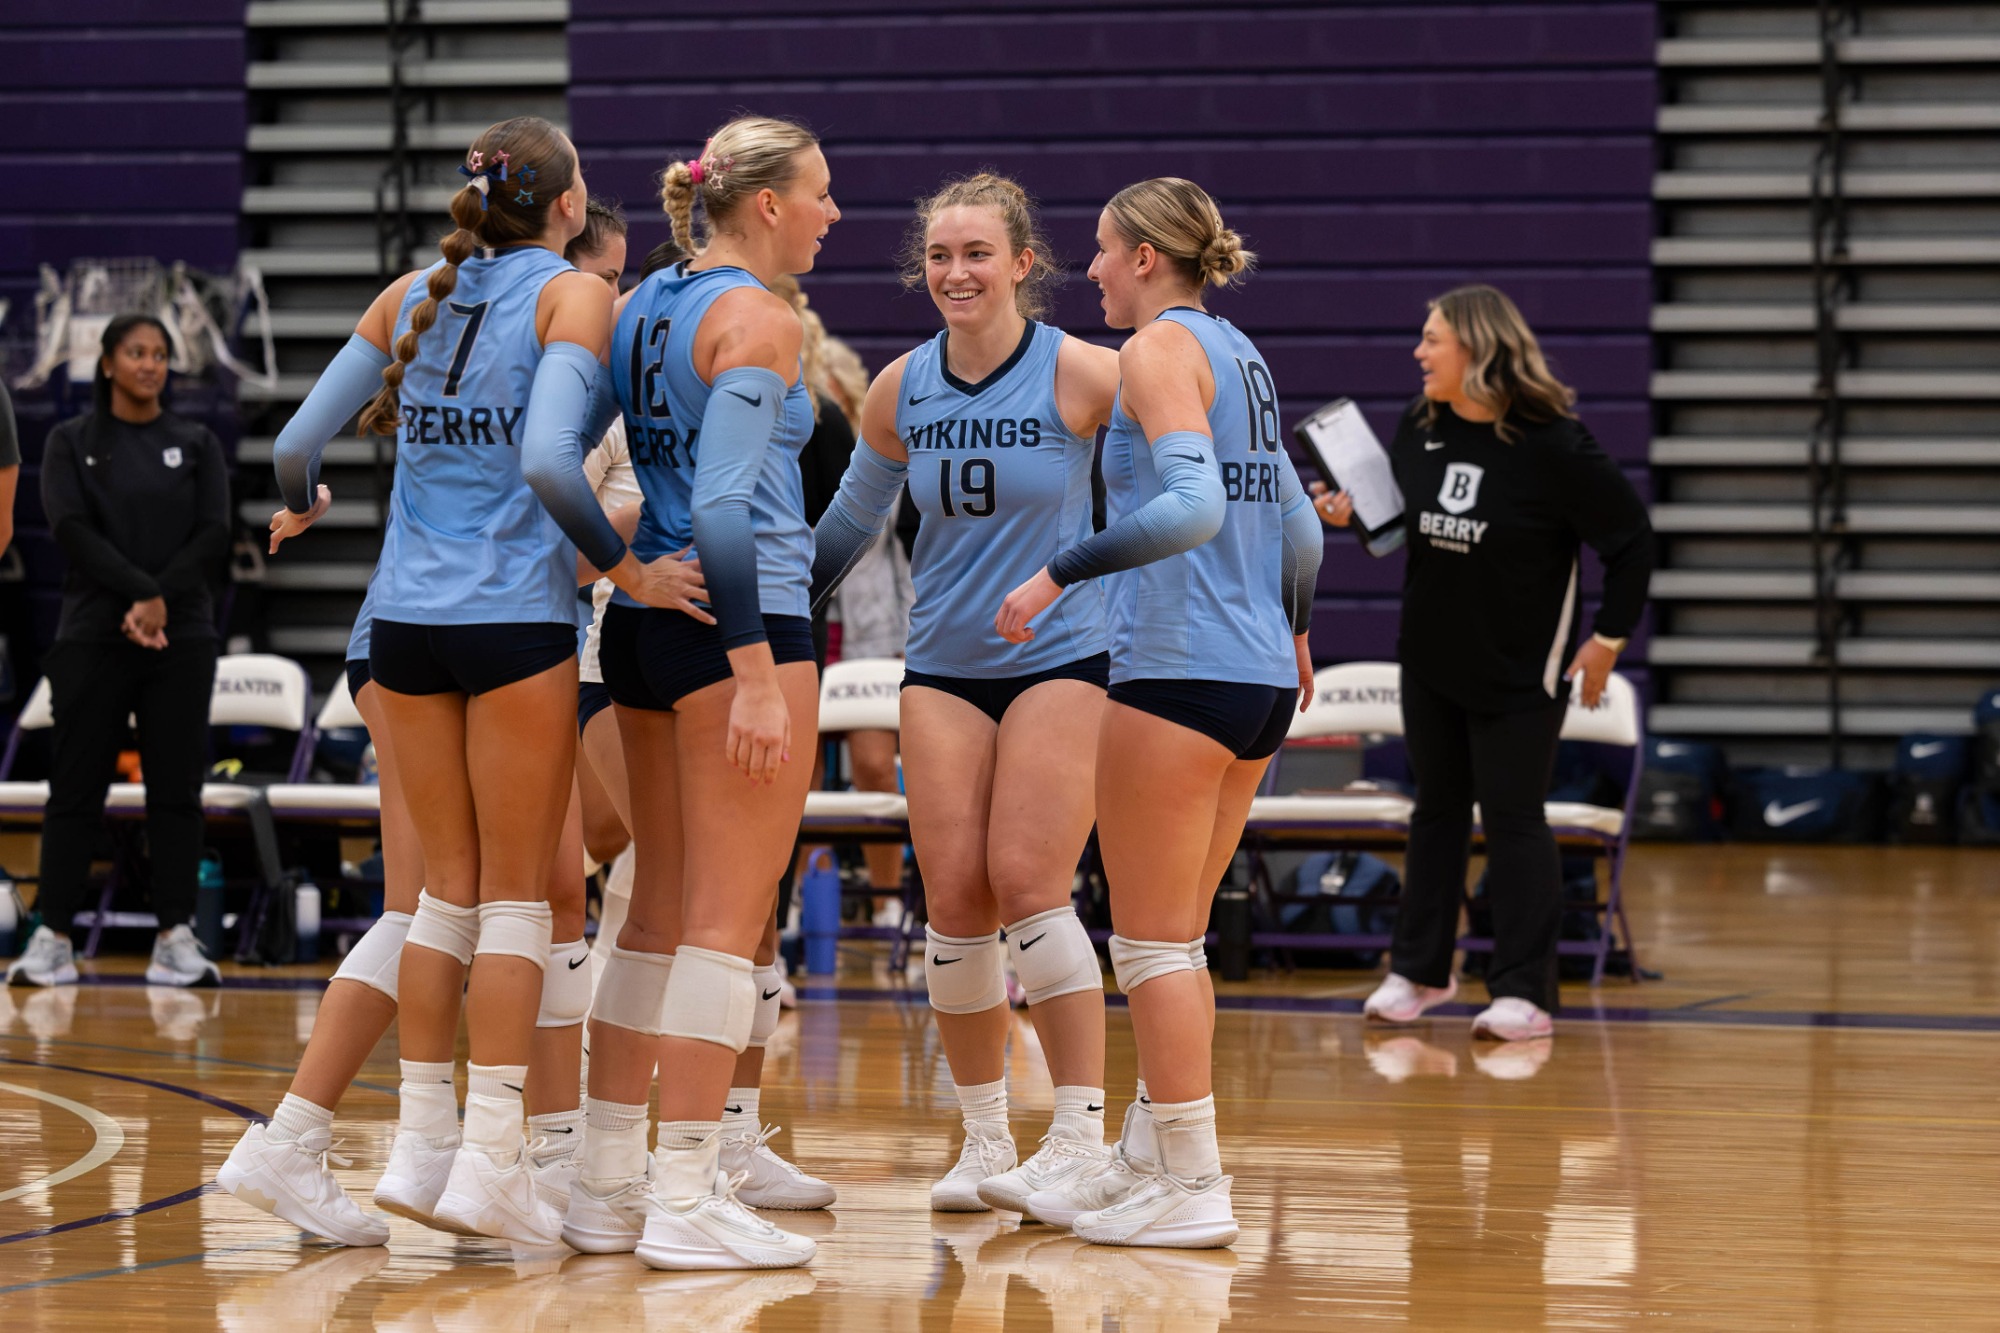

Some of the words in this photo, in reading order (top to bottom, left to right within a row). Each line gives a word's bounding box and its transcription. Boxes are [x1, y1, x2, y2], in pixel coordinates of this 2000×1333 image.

[442, 300, 489, 398] 7
[630, 315, 672, 418] 12
[402, 405, 524, 446] BERRY
[1234, 356, 1278, 454] 18
[625, 425, 700, 468] ERRY
[908, 417, 1041, 450] VIKINGS
[939, 457, 996, 518] 19
[1448, 471, 1471, 501] B
[1419, 511, 1489, 543] BERRY
[215, 679, 283, 696] RANTON
